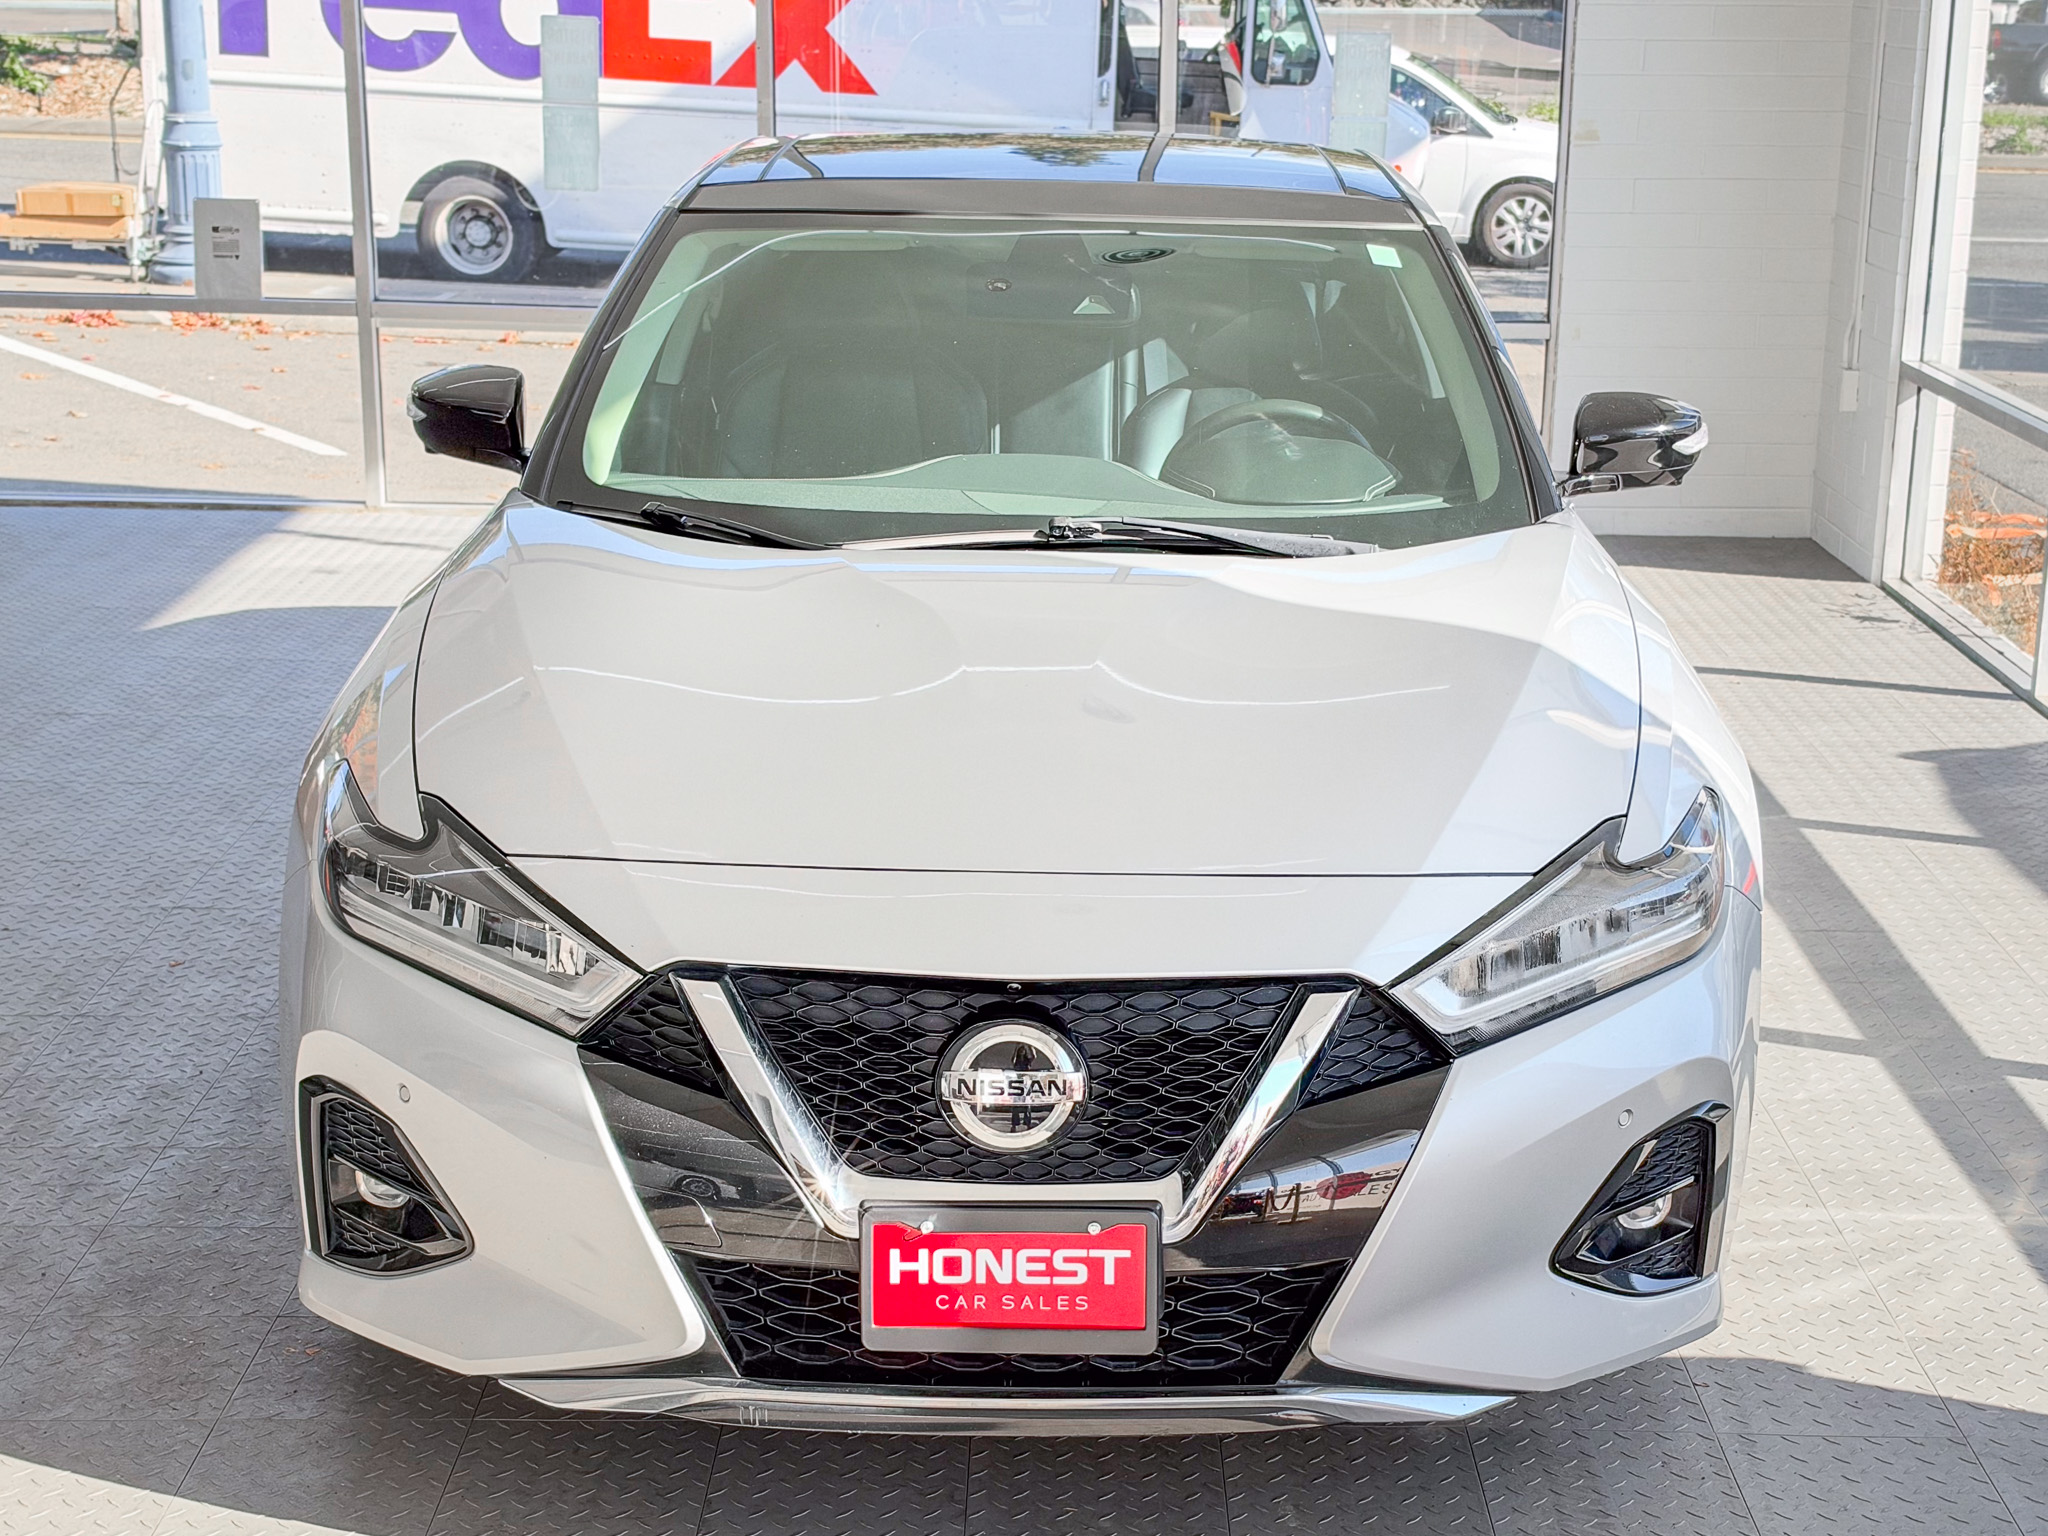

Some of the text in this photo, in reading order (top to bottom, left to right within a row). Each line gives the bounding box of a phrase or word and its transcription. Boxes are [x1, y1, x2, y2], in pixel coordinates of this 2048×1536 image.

[956, 1077, 1068, 1097] NISSAN
[889, 1247, 1132, 1285] HONEST
[935, 1295, 1089, 1311] CAR SALES
